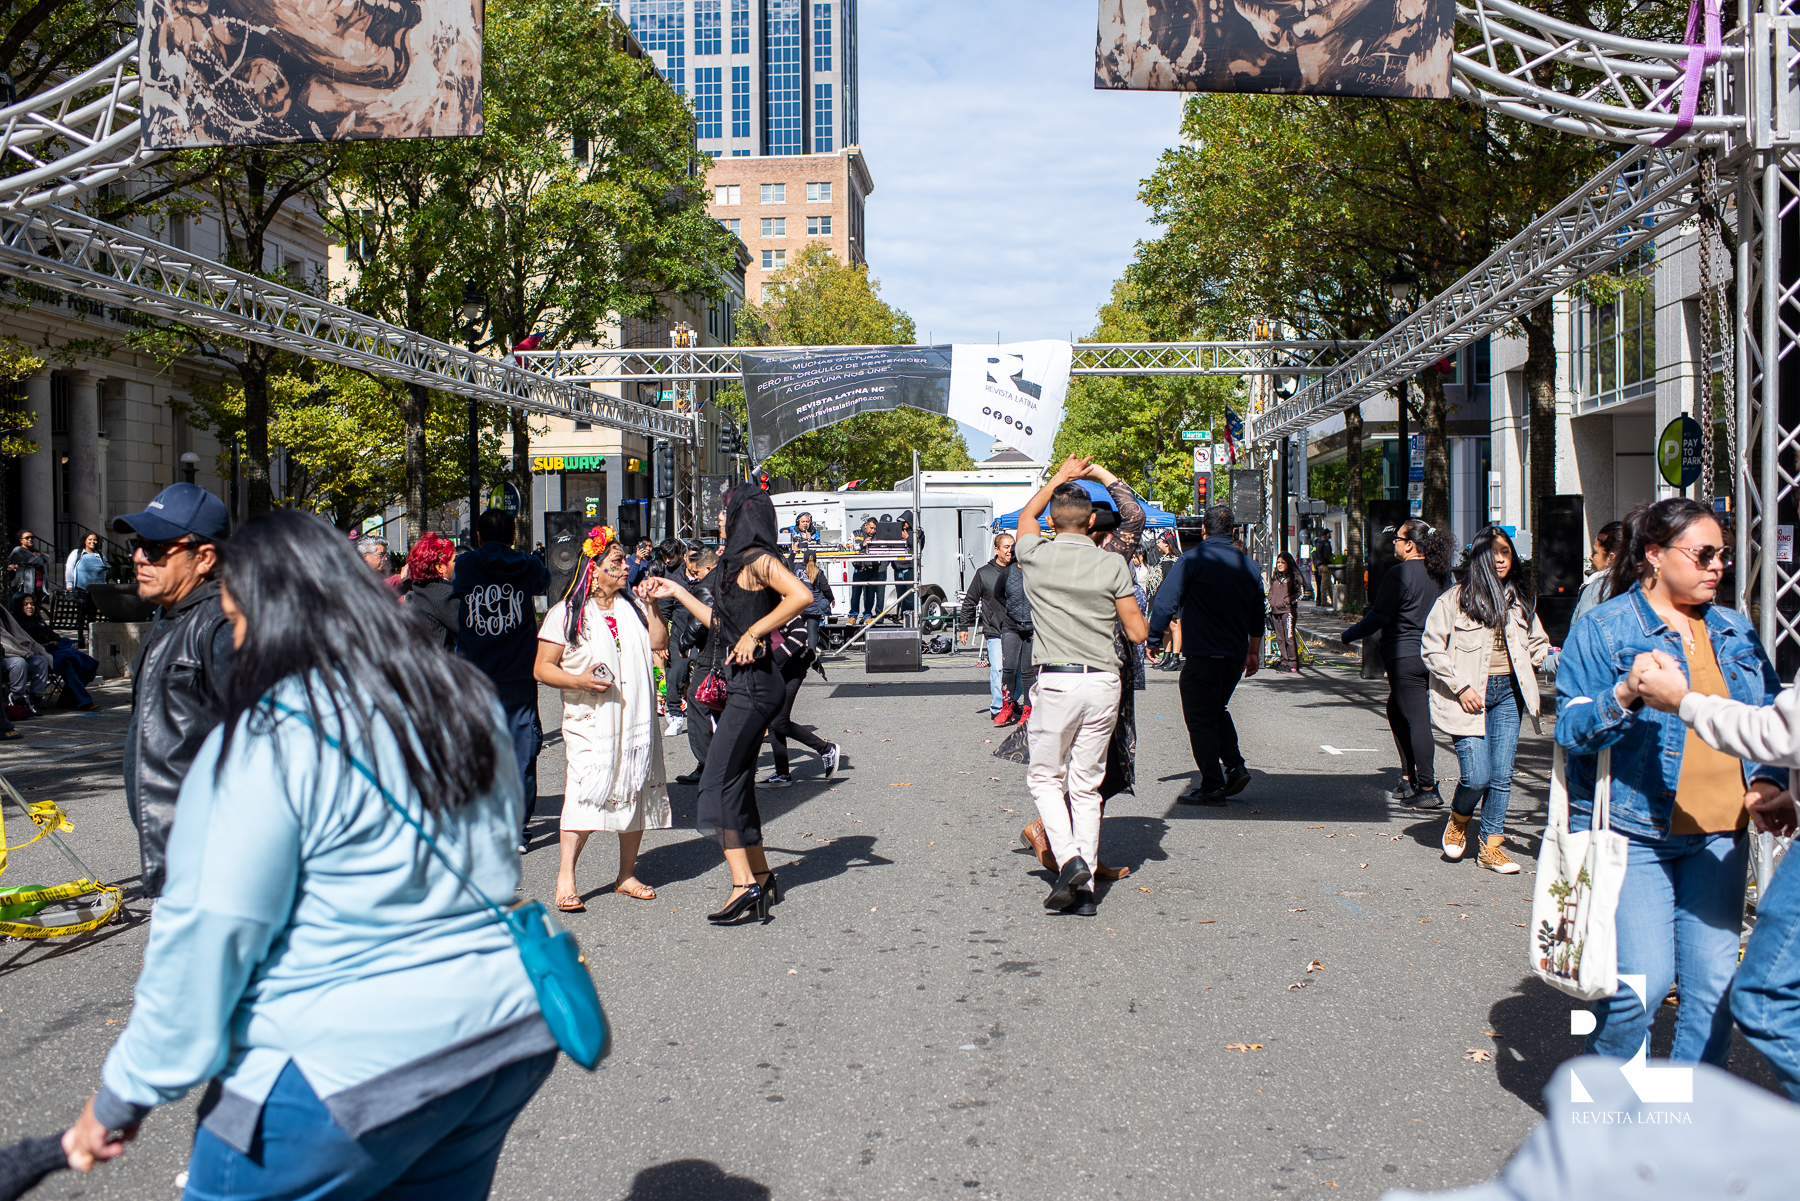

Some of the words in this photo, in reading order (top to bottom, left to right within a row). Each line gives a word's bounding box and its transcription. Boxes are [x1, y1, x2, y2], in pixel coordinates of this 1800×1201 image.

[757, 378, 782, 392] PERO
[796, 364, 843, 379] ORGULLO
[861, 357, 928, 367] PERTENECER
[792, 359, 834, 371] MUCHAS
[786, 387, 793, 395] A
[793, 379, 820, 391] CADA
[821, 374, 842, 383] UNA
[843, 370, 865, 379] NOS
[796, 396, 834, 415] REVISTA
[834, 387, 869, 401] LATINA
[985, 384, 1013, 401] REVISTA
[1014, 395, 1038, 412] LATINA
[1664, 440, 1680, 466] P
[1682, 438, 1699, 448] PAY
[1683, 447, 1694, 456] TO
[531, 455, 605, 471] SUBWAY
[1682, 457, 1702, 466] PARK
